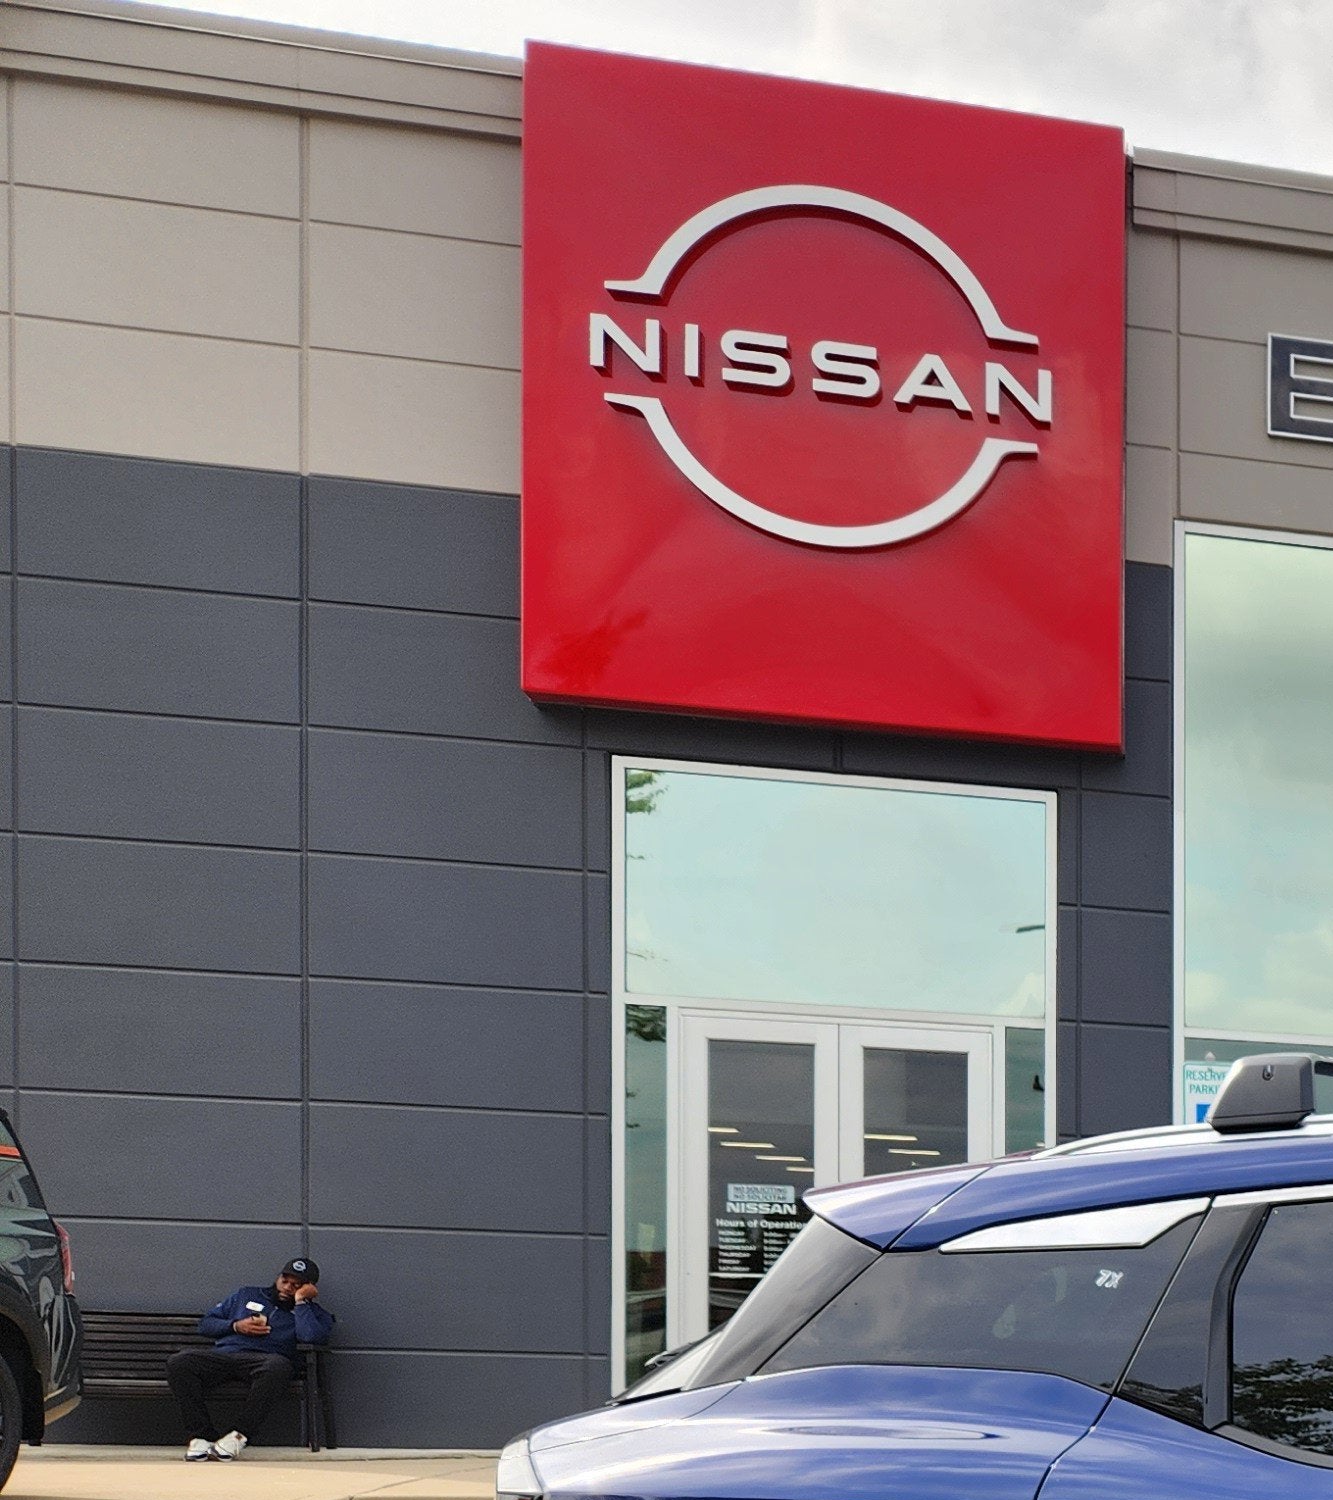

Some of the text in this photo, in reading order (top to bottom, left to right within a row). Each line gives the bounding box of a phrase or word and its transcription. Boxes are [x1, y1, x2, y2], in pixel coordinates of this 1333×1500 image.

[589, 312, 1053, 425] NISSAN
[1189, 1084, 1220, 1095] PARKI
[726, 1202, 797, 1215] NISSAN
[716, 1218, 745, 1228] Hours
[747, 1219, 757, 1228] of
